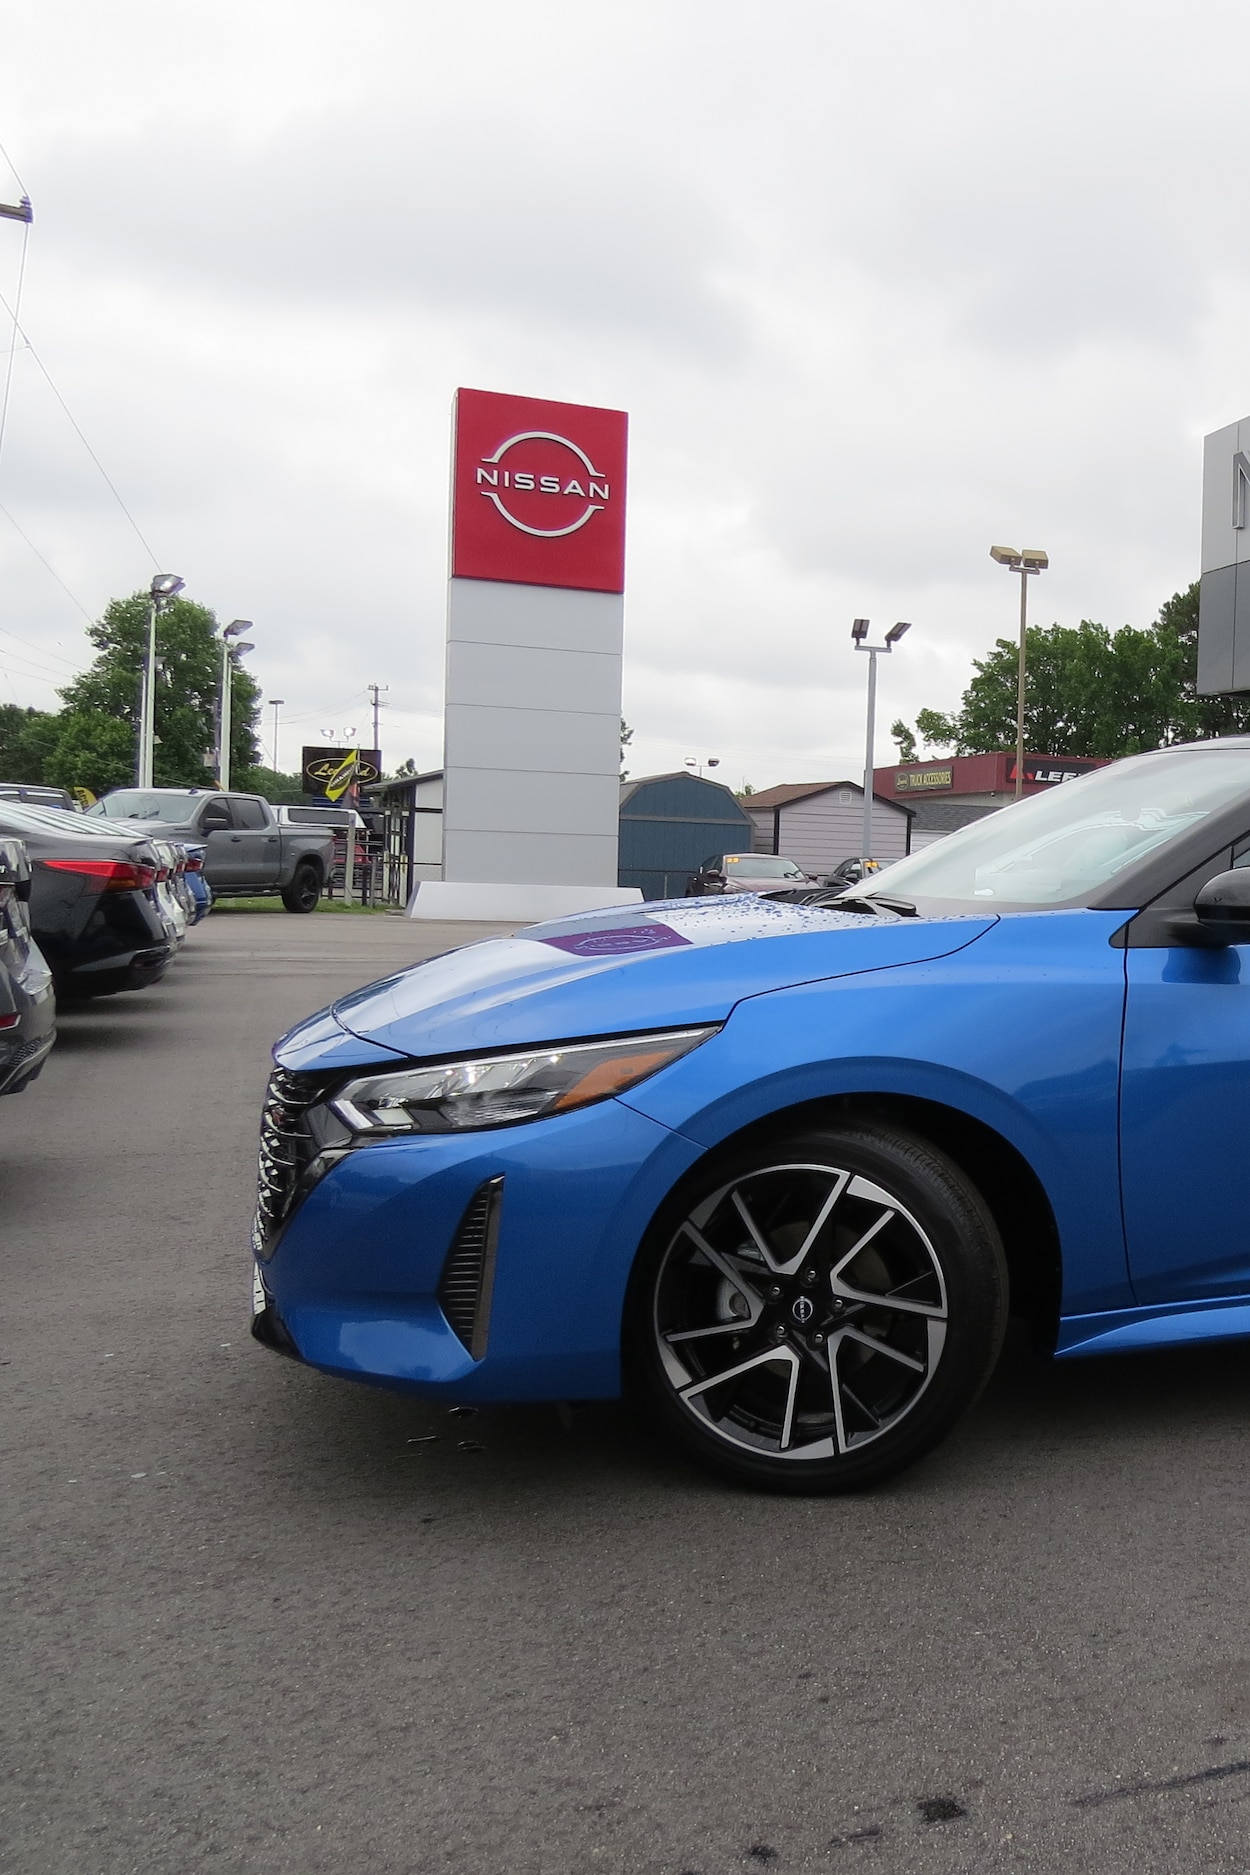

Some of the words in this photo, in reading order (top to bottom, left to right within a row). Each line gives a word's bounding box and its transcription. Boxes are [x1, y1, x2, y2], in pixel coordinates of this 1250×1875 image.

[476, 467, 609, 500] NISSAN
[314, 763, 371, 777] Led
[1034, 770, 1081, 782] LEE
